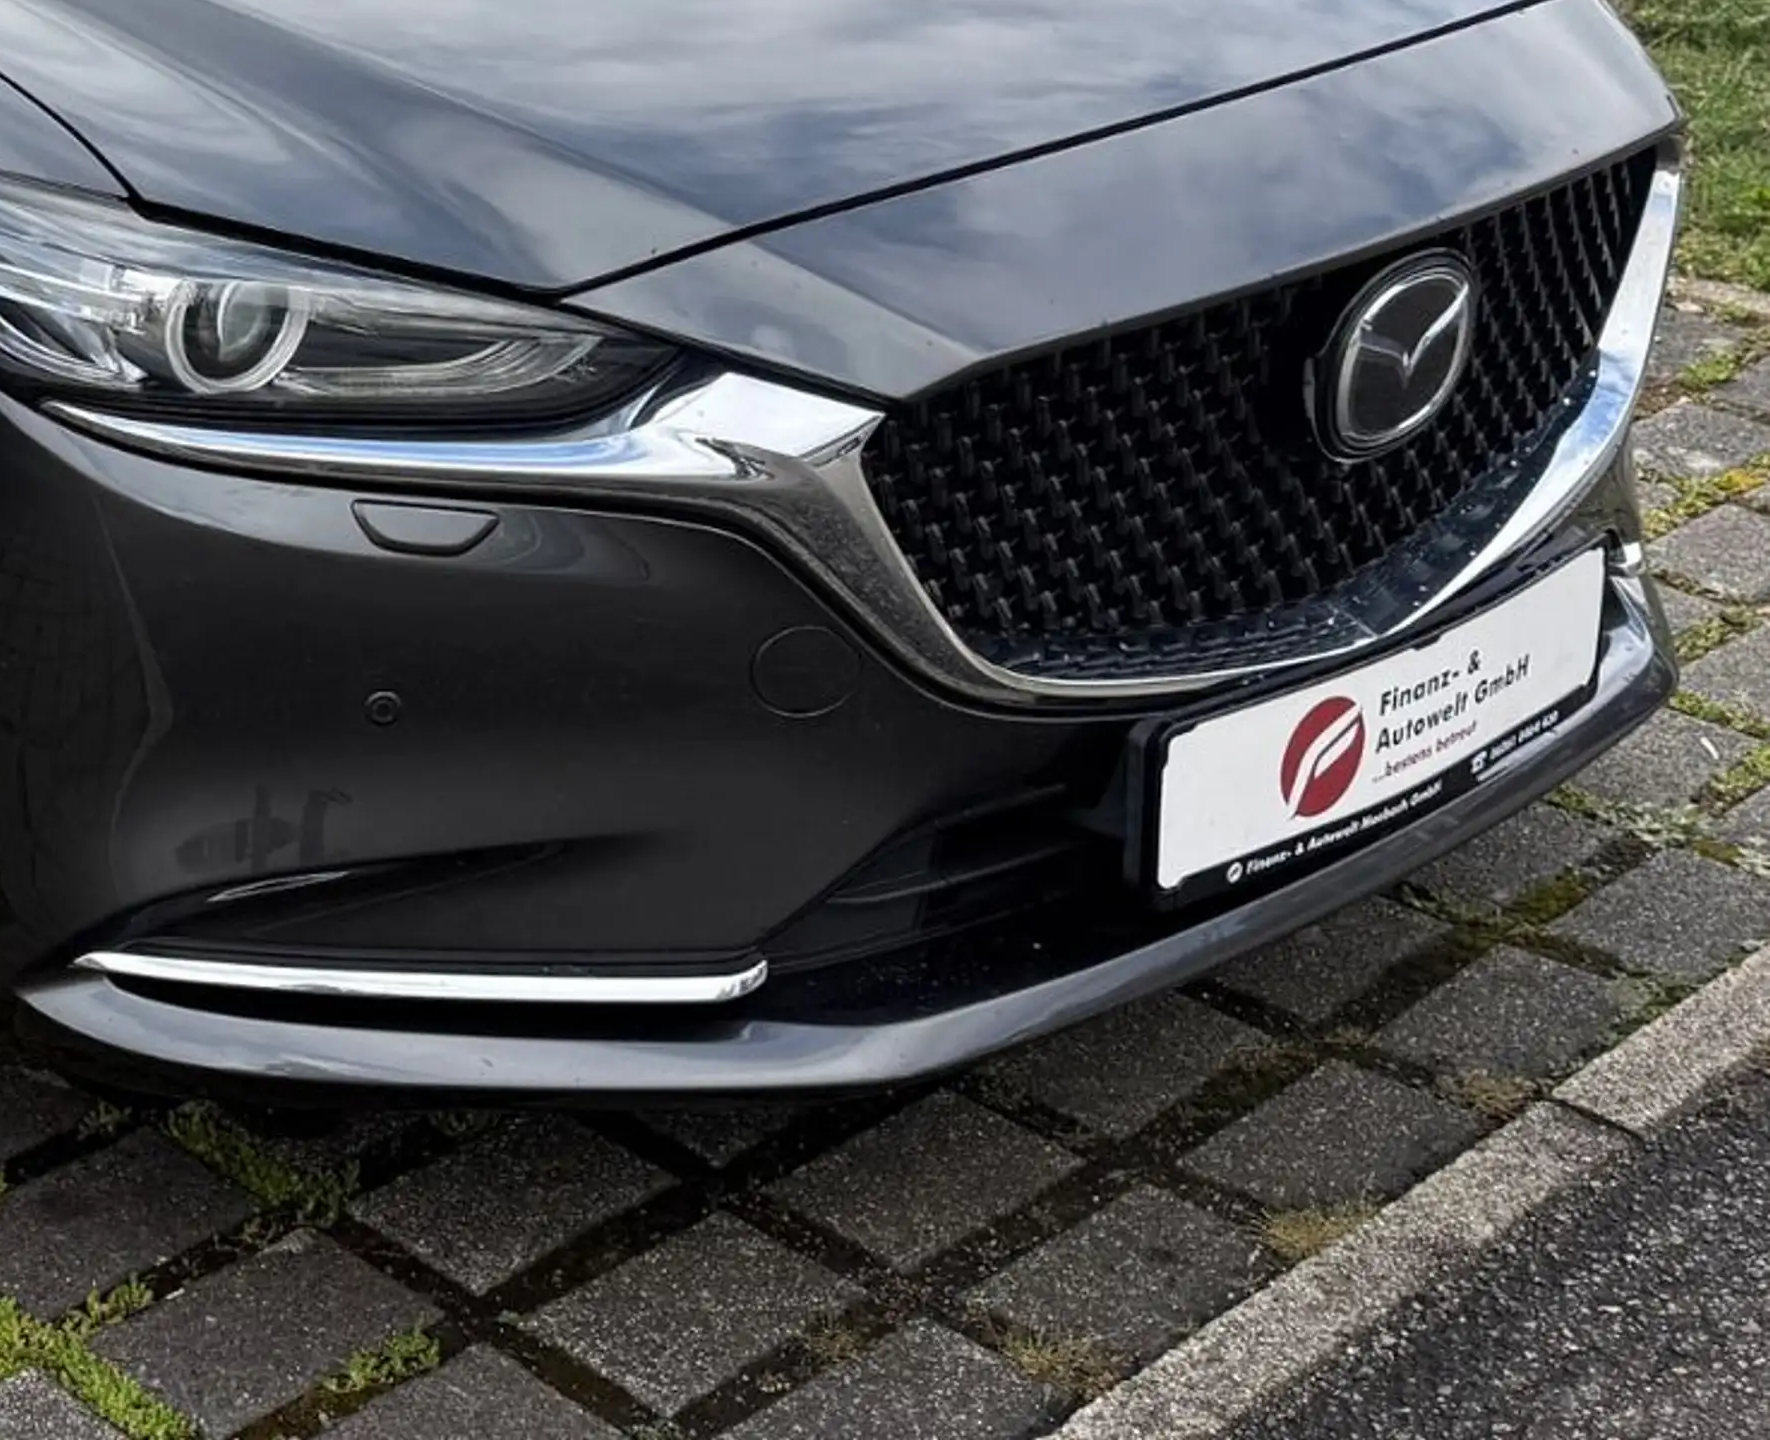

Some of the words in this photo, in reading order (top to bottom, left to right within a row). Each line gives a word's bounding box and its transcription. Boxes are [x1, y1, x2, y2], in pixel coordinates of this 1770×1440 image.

[1375, 691, 1469, 754] Autowelt
[1474, 653, 1530, 704] GmbH
[1379, 669, 1460, 716] Finanz-
[1467, 649, 1481, 675] &
